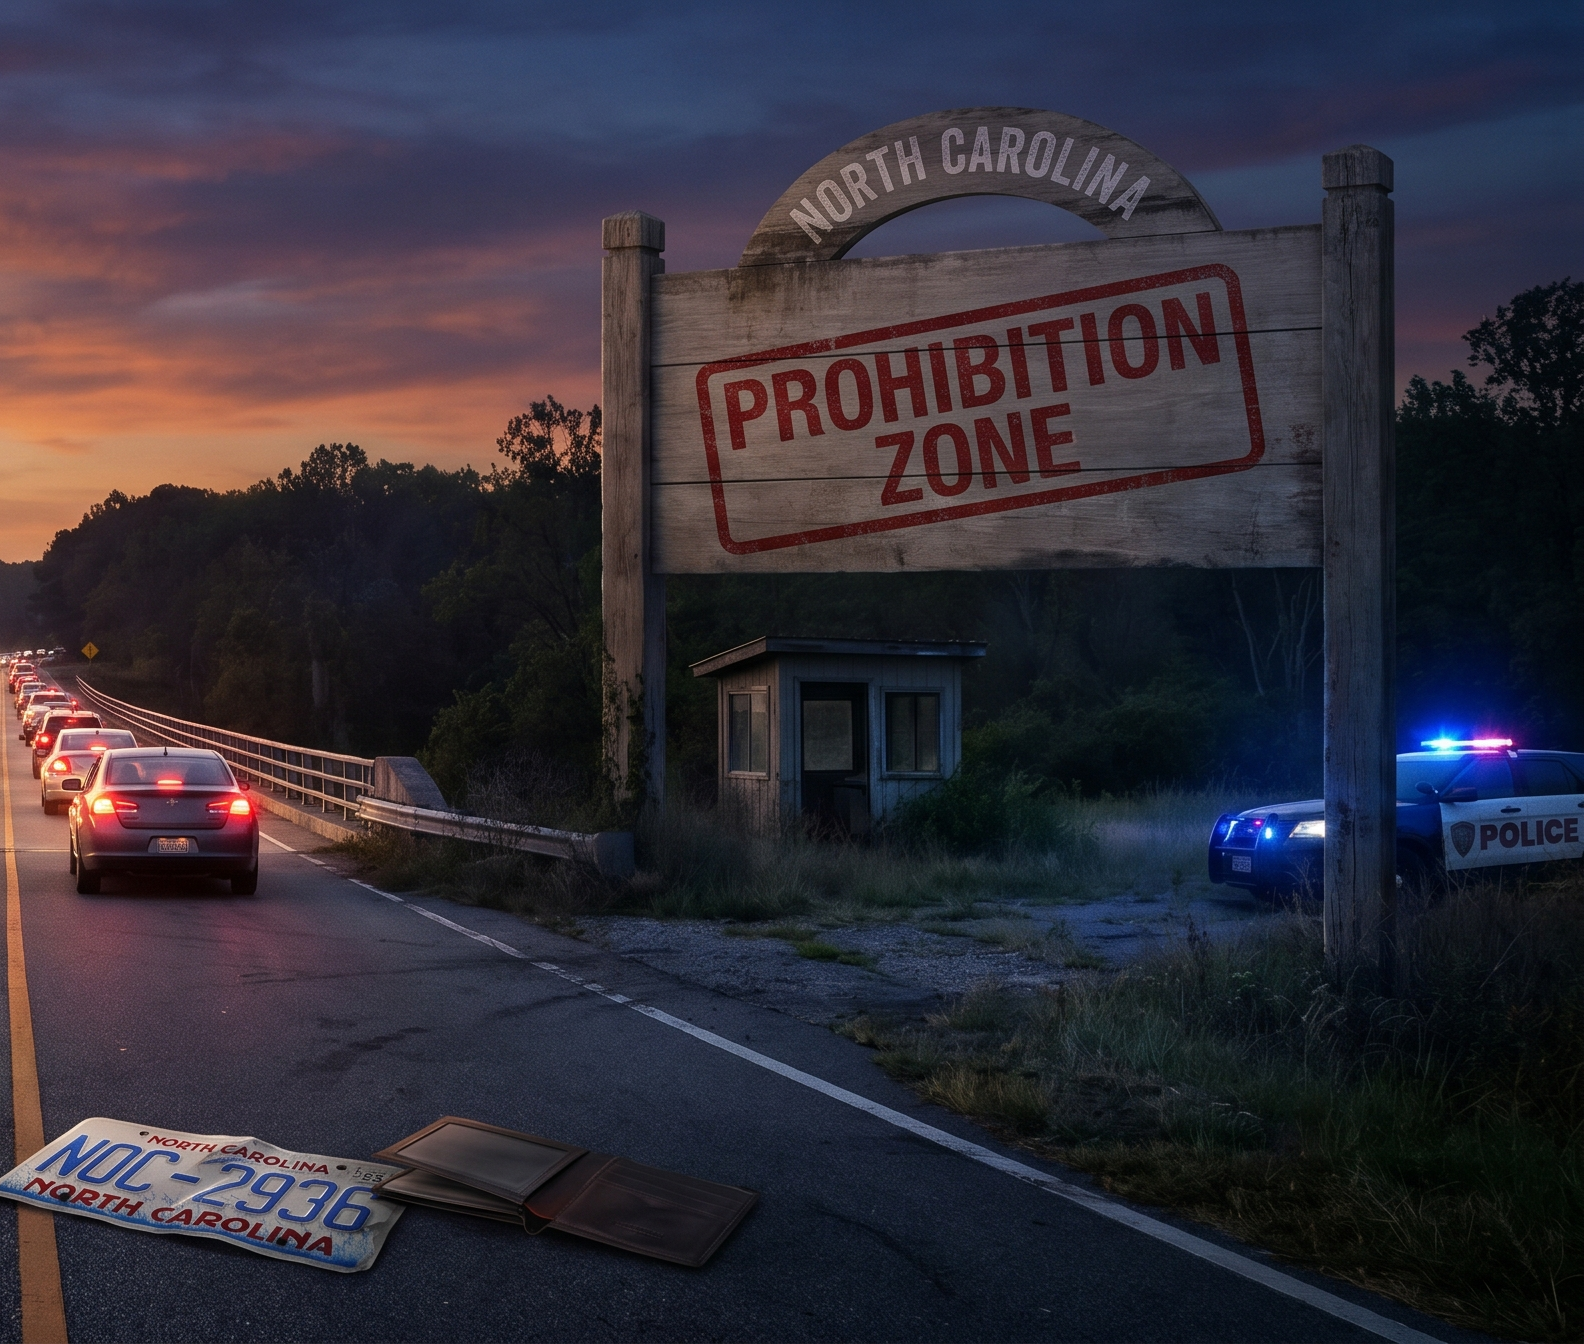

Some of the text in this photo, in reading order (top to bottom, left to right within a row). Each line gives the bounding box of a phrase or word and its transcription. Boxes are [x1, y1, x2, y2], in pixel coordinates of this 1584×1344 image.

[789, 126, 1152, 244] NORTH CAROLINA
[723, 291, 1221, 451] PROHIBITION
[875, 403, 1082, 507] ZONE
[1480, 818, 1579, 850] POLICE
[34, 1134, 379, 1231] NOC-2936
[147, 1135, 218, 1154] NORTH
[220, 1144, 329, 1175] CAROLINA
[23, 1177, 333, 1257] NORTH CAROLINA
